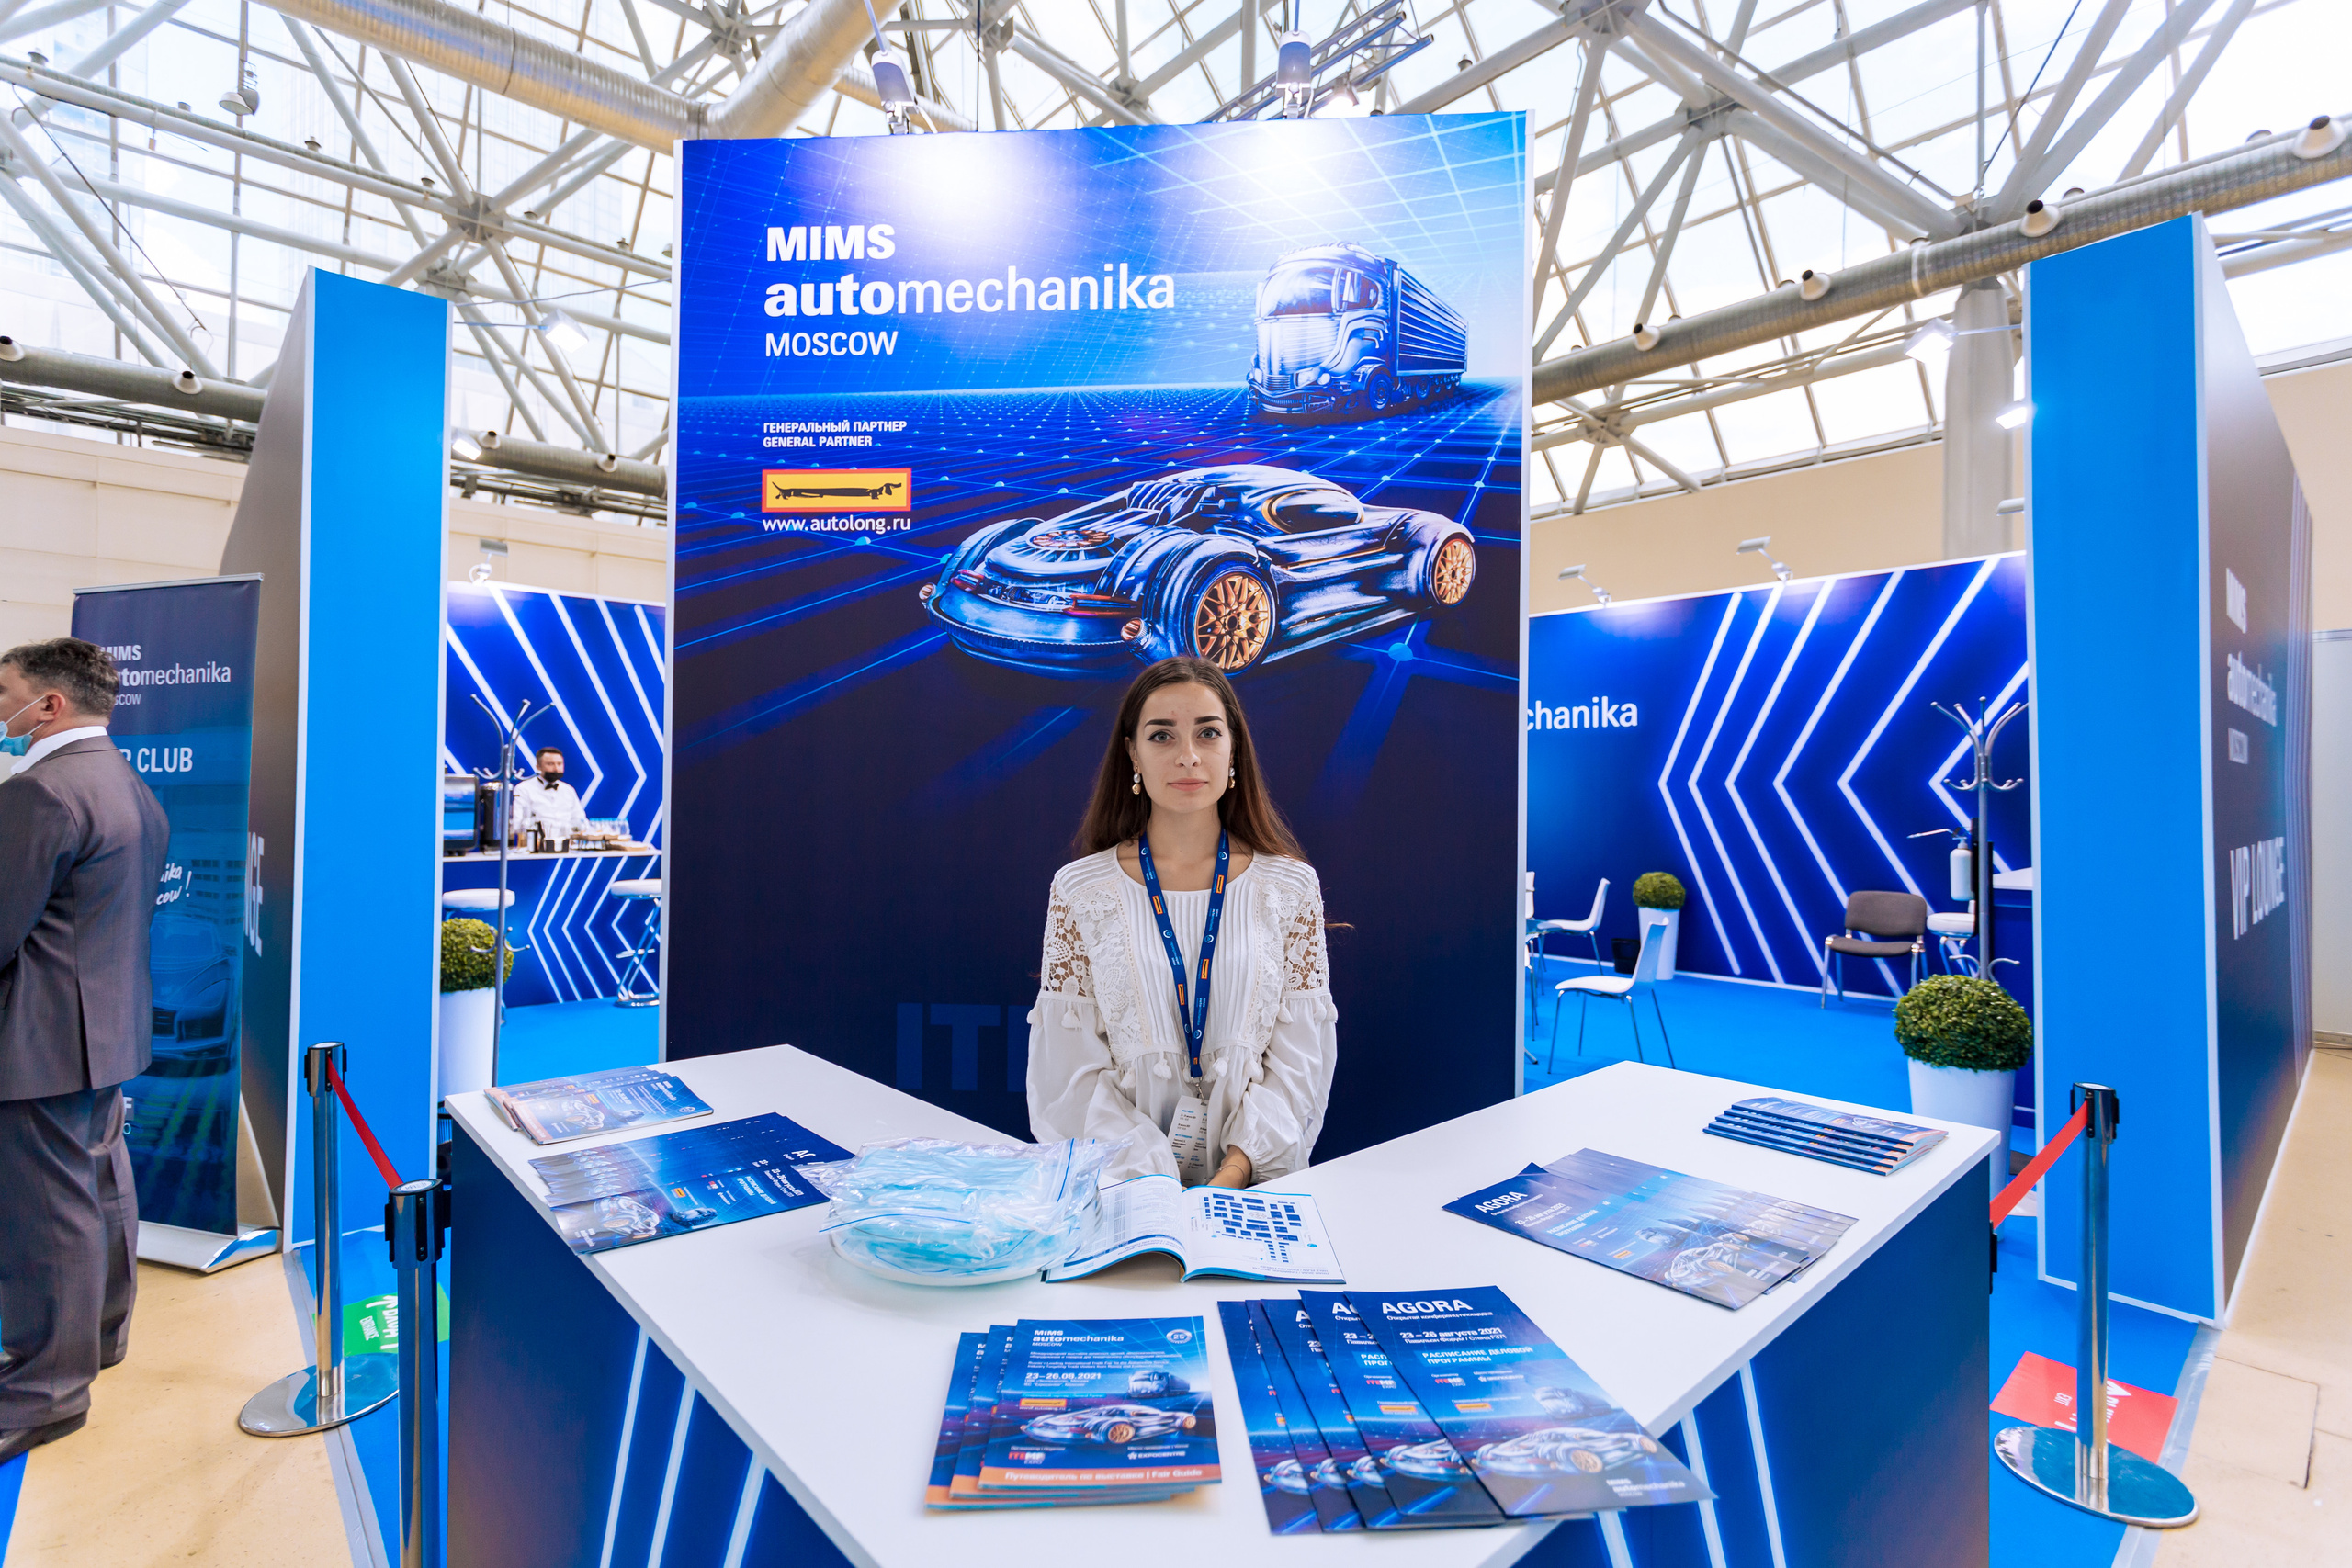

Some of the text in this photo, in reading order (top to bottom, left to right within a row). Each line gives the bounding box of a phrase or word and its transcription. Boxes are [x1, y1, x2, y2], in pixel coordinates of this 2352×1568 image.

[767, 224, 896, 262] MIMS
[764, 263, 1175, 317] automechanika
[765, 331, 899, 357] MOSCOW
[763, 420, 908, 434] ГЕНЕРАЛЬНЫЙ ПАРТНЕР
[763, 435, 873, 447] GENERAL PARTNER
[762, 514, 911, 535] www.autolong.ru
[137, 747, 193, 773] CLUB
[2230, 846, 2250, 940] VIP
[1475, 1191, 1528, 1213] AGORA
[1382, 1299, 1474, 1314] AGORA
[1033, 1335, 1125, 1343] automechanika
[1439, 1329, 1477, 1338] августа
[1478, 1327, 1503, 1336] 2021
[1422, 1346, 1533, 1359] РАСПИСАНИЕ ДЕЛОВОЙ
[1427, 1356, 1491, 1365] ПРОГРАММЫ
[1005, 1472, 1078, 1481] Путеводитель
[1152, 1470, 1170, 1479] Fair
[1172, 1469, 1202, 1478] Guide
